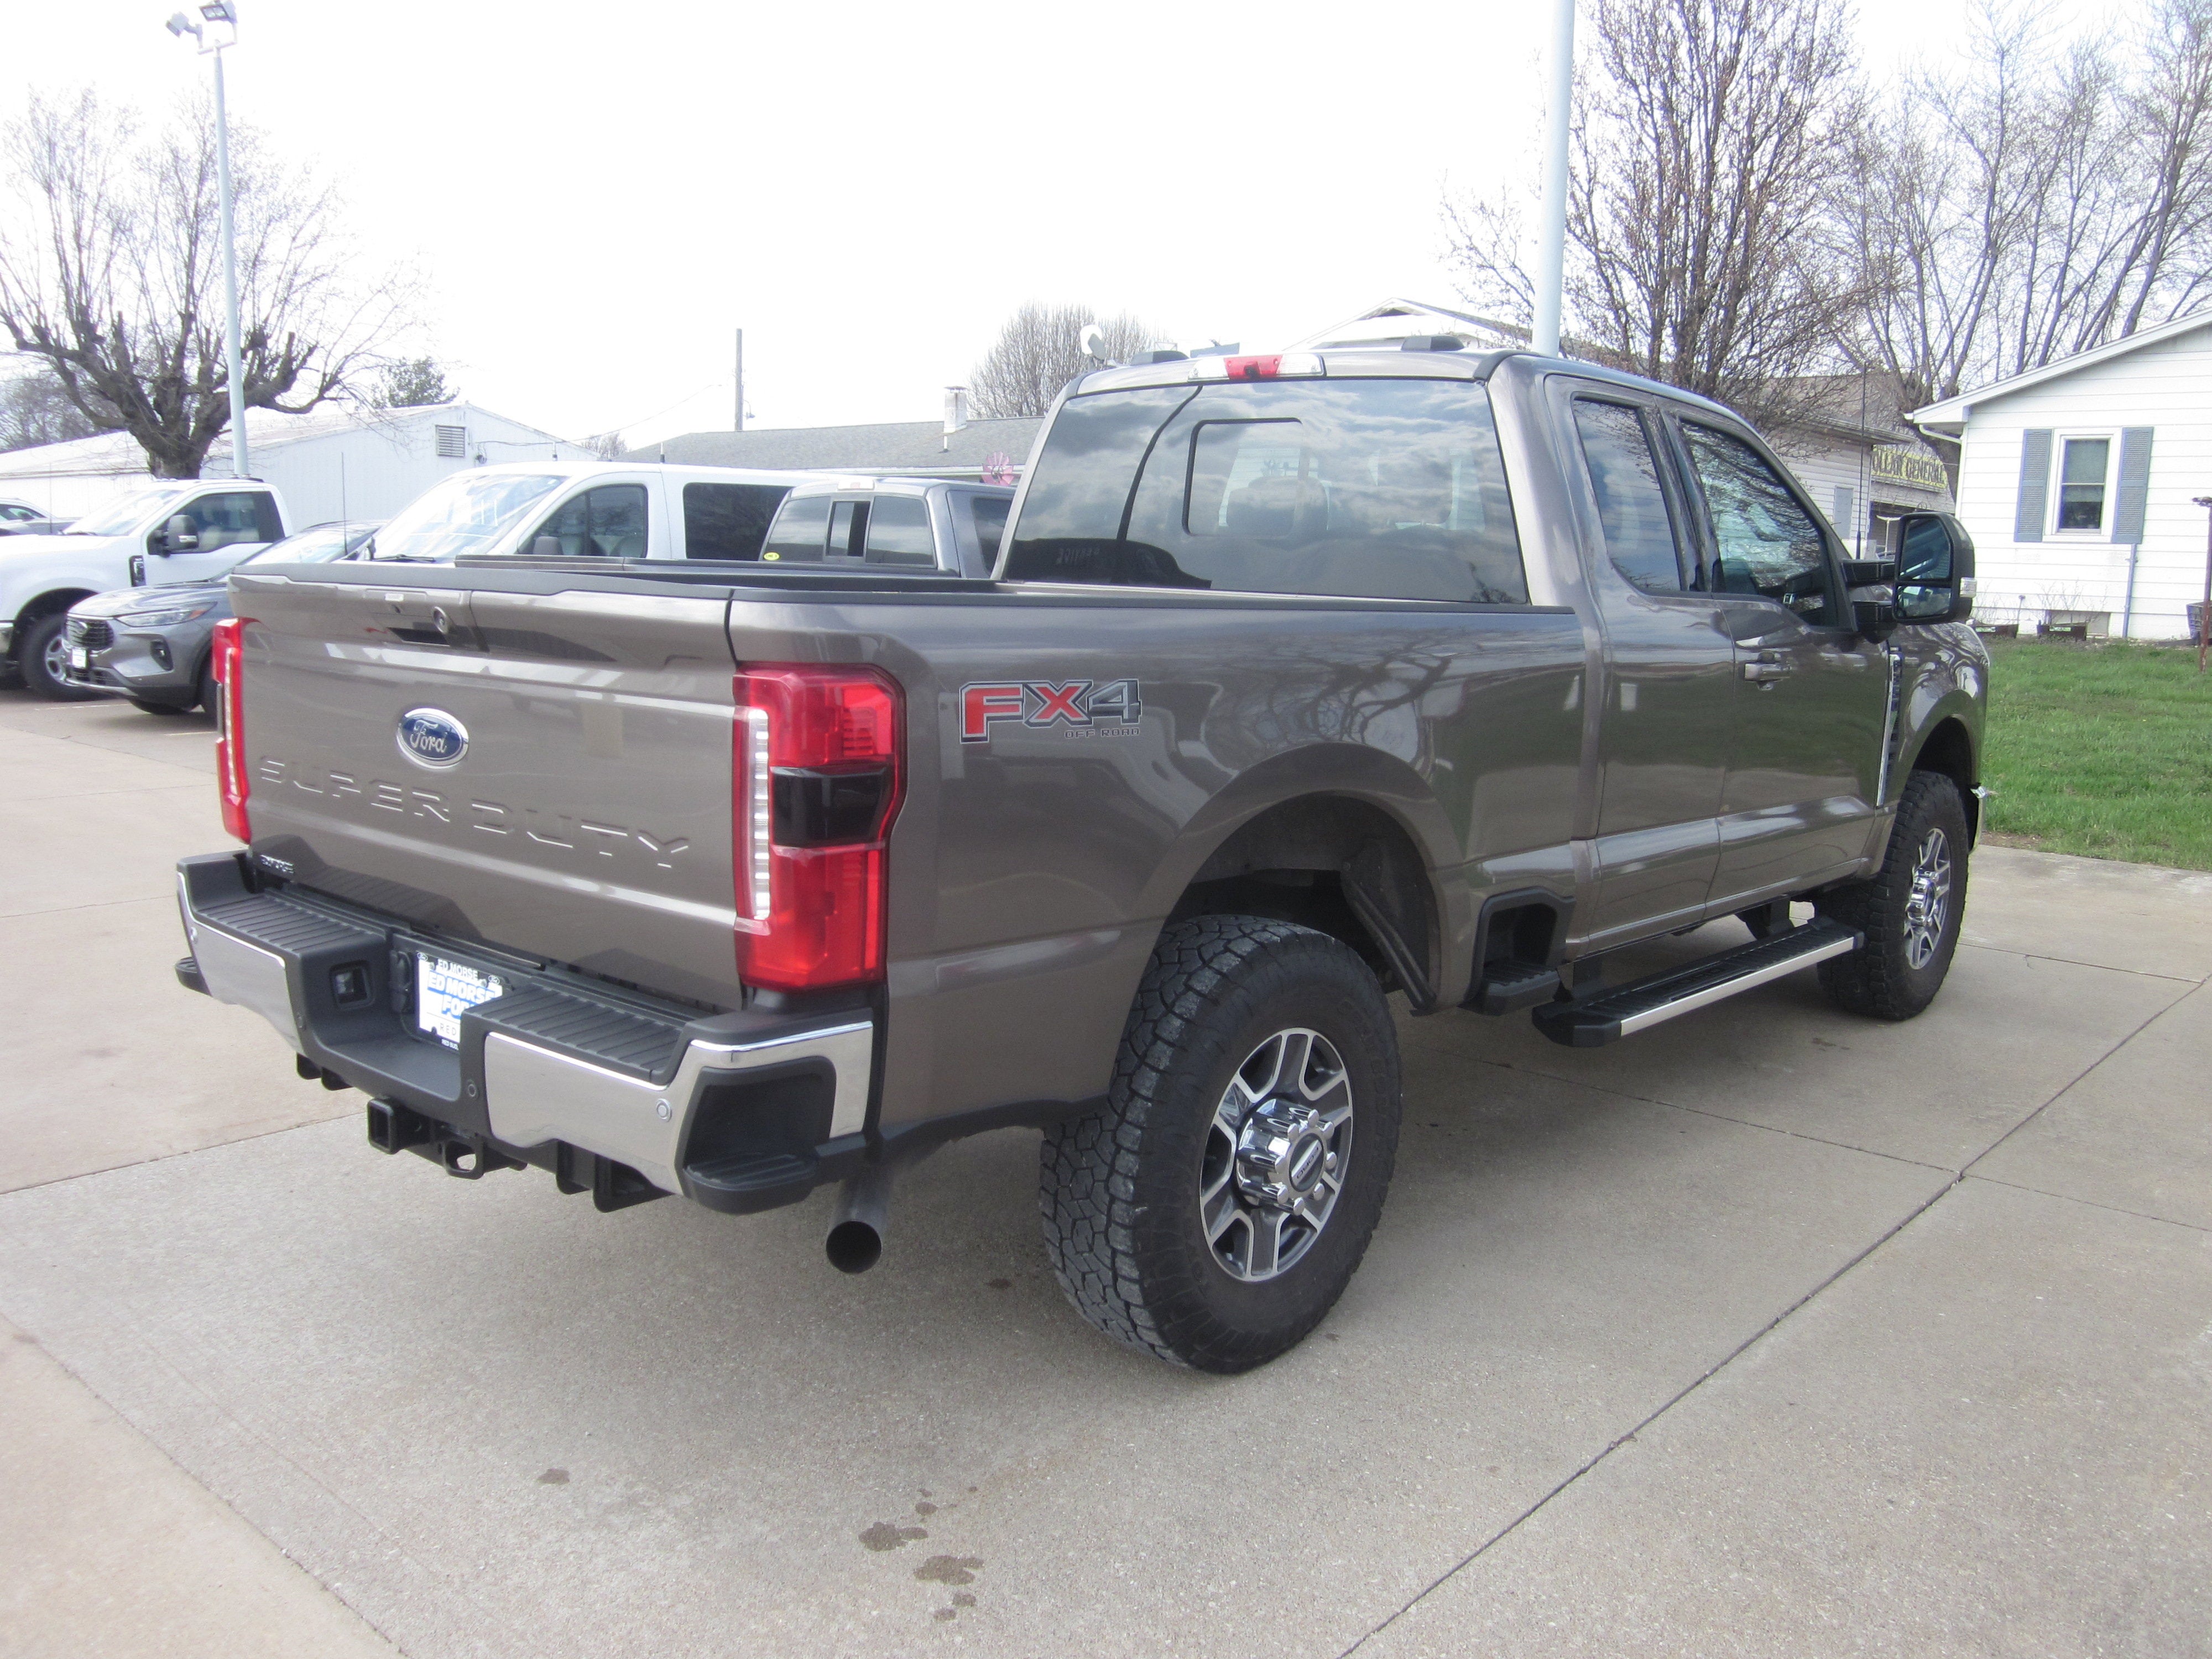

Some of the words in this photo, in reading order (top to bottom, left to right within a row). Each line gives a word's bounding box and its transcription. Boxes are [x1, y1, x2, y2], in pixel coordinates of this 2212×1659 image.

[1872, 451, 1903, 477] OLLAR
[959, 679, 1142, 744] FX4
[409, 719, 447, 754] Ford
[1064, 729, 1095, 739] OFF
[1100, 728, 1140, 738] ROAD
[260, 755, 450, 822] SUPER
[471, 797, 688, 869] DUTY
[427, 970, 446, 992] ED
[437, 959, 448, 971] ED
[449, 963, 478, 980] MORSE
[440, 1023, 457, 1036] RED
